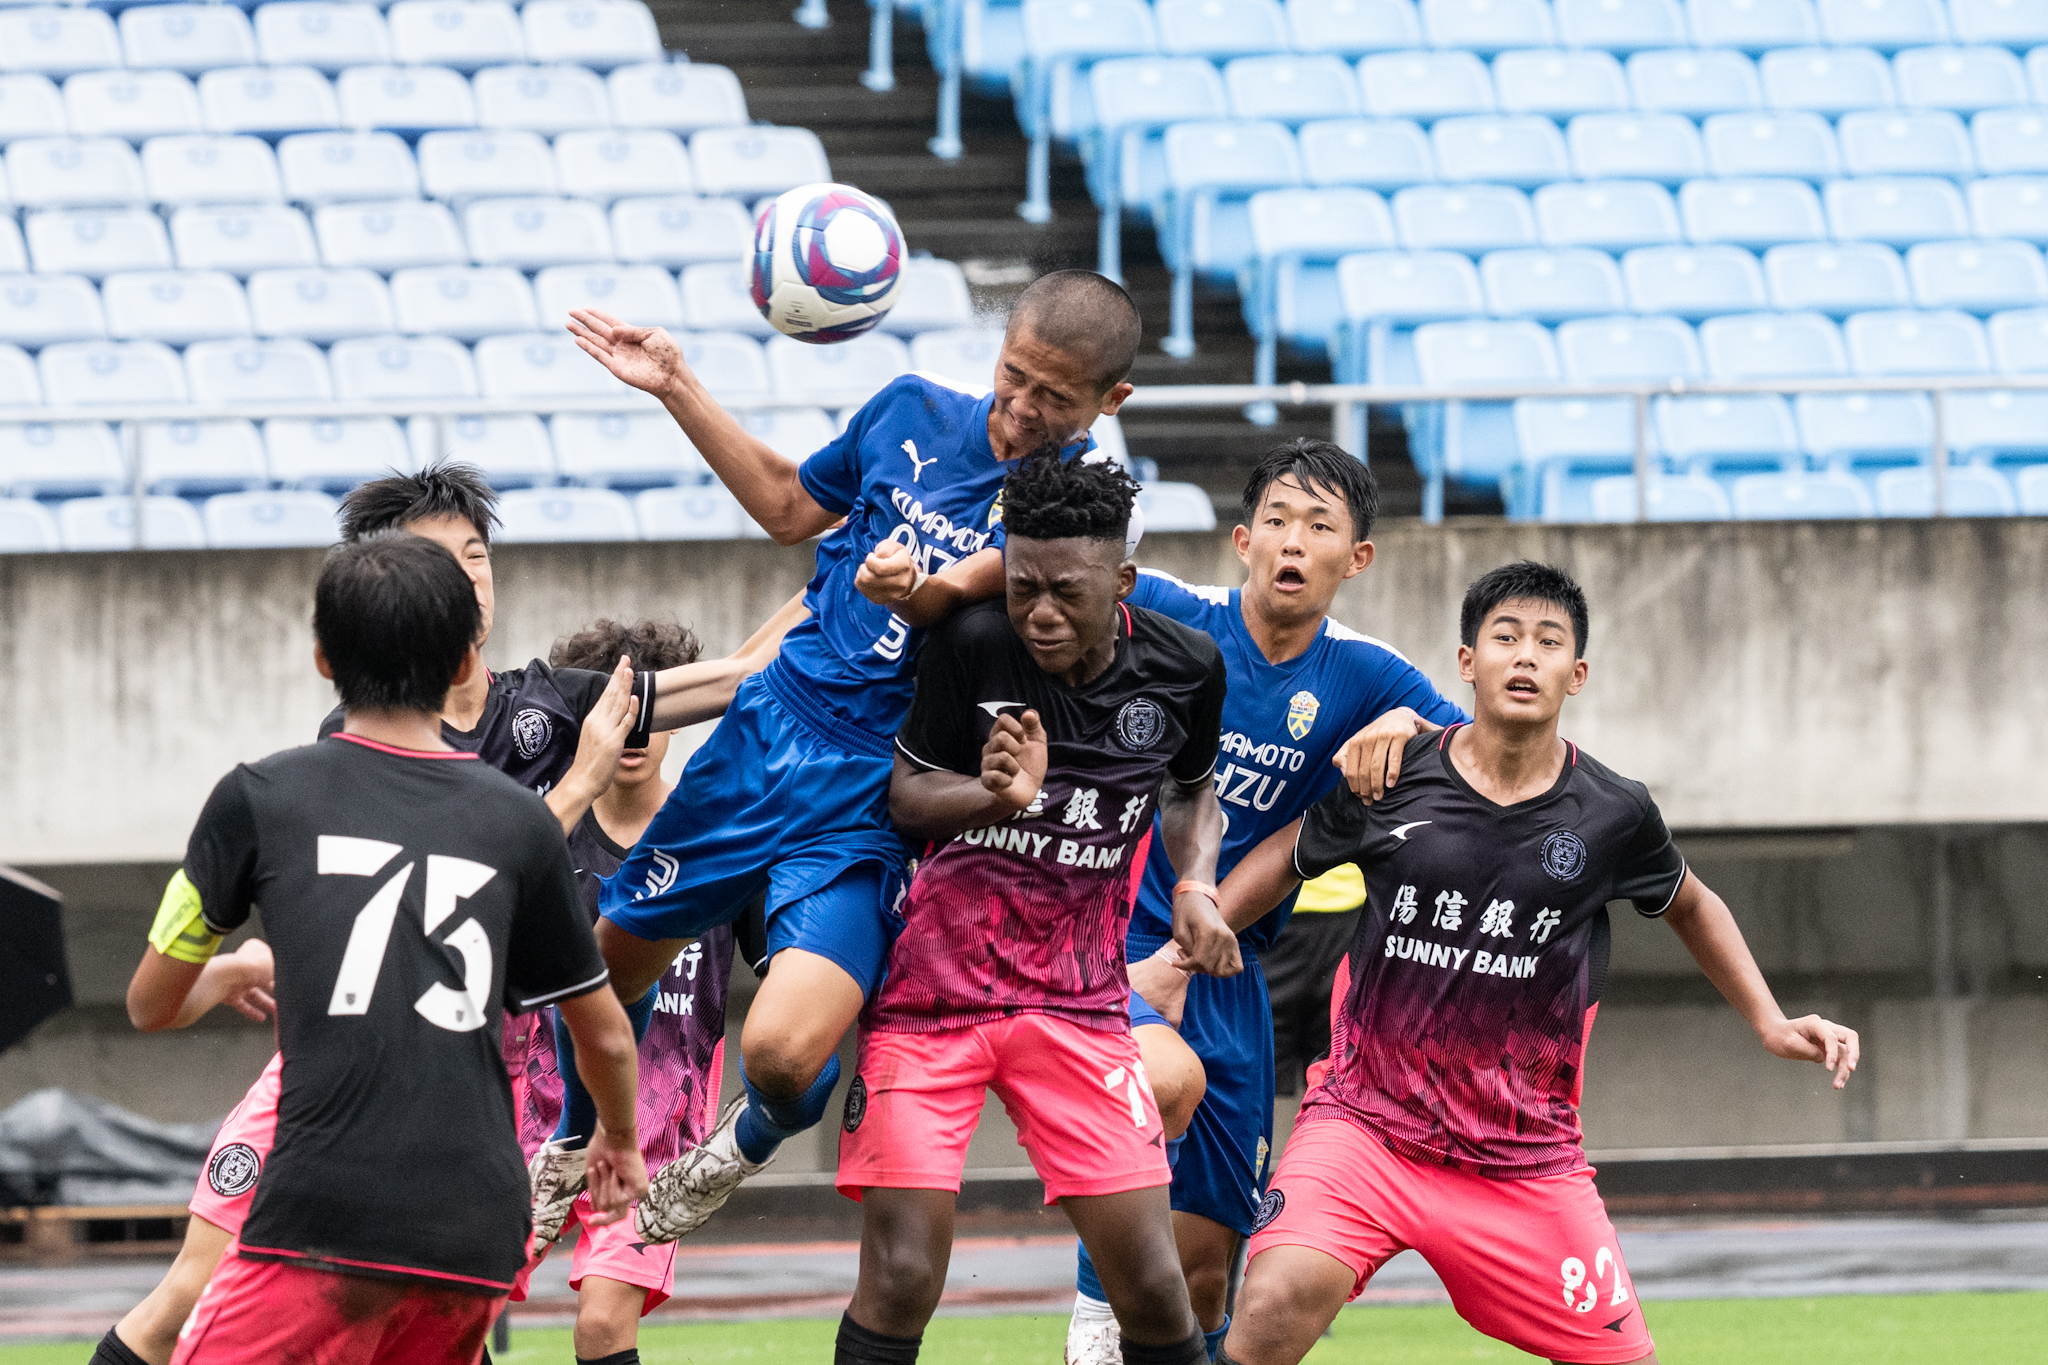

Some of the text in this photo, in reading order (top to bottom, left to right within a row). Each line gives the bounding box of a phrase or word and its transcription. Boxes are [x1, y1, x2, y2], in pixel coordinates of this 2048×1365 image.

[1219, 730, 1306, 772] MAMOTO
[1213, 762, 1288, 812] HZU
[953, 825, 1127, 870] UNNY BANK
[317, 834, 498, 1032] 75
[1389, 884, 1562, 944] 陽信銀行
[1384, 934, 1540, 979] SUNNY BANK
[653, 991, 695, 1016] ANK
[1560, 1246, 1630, 1313] 82
